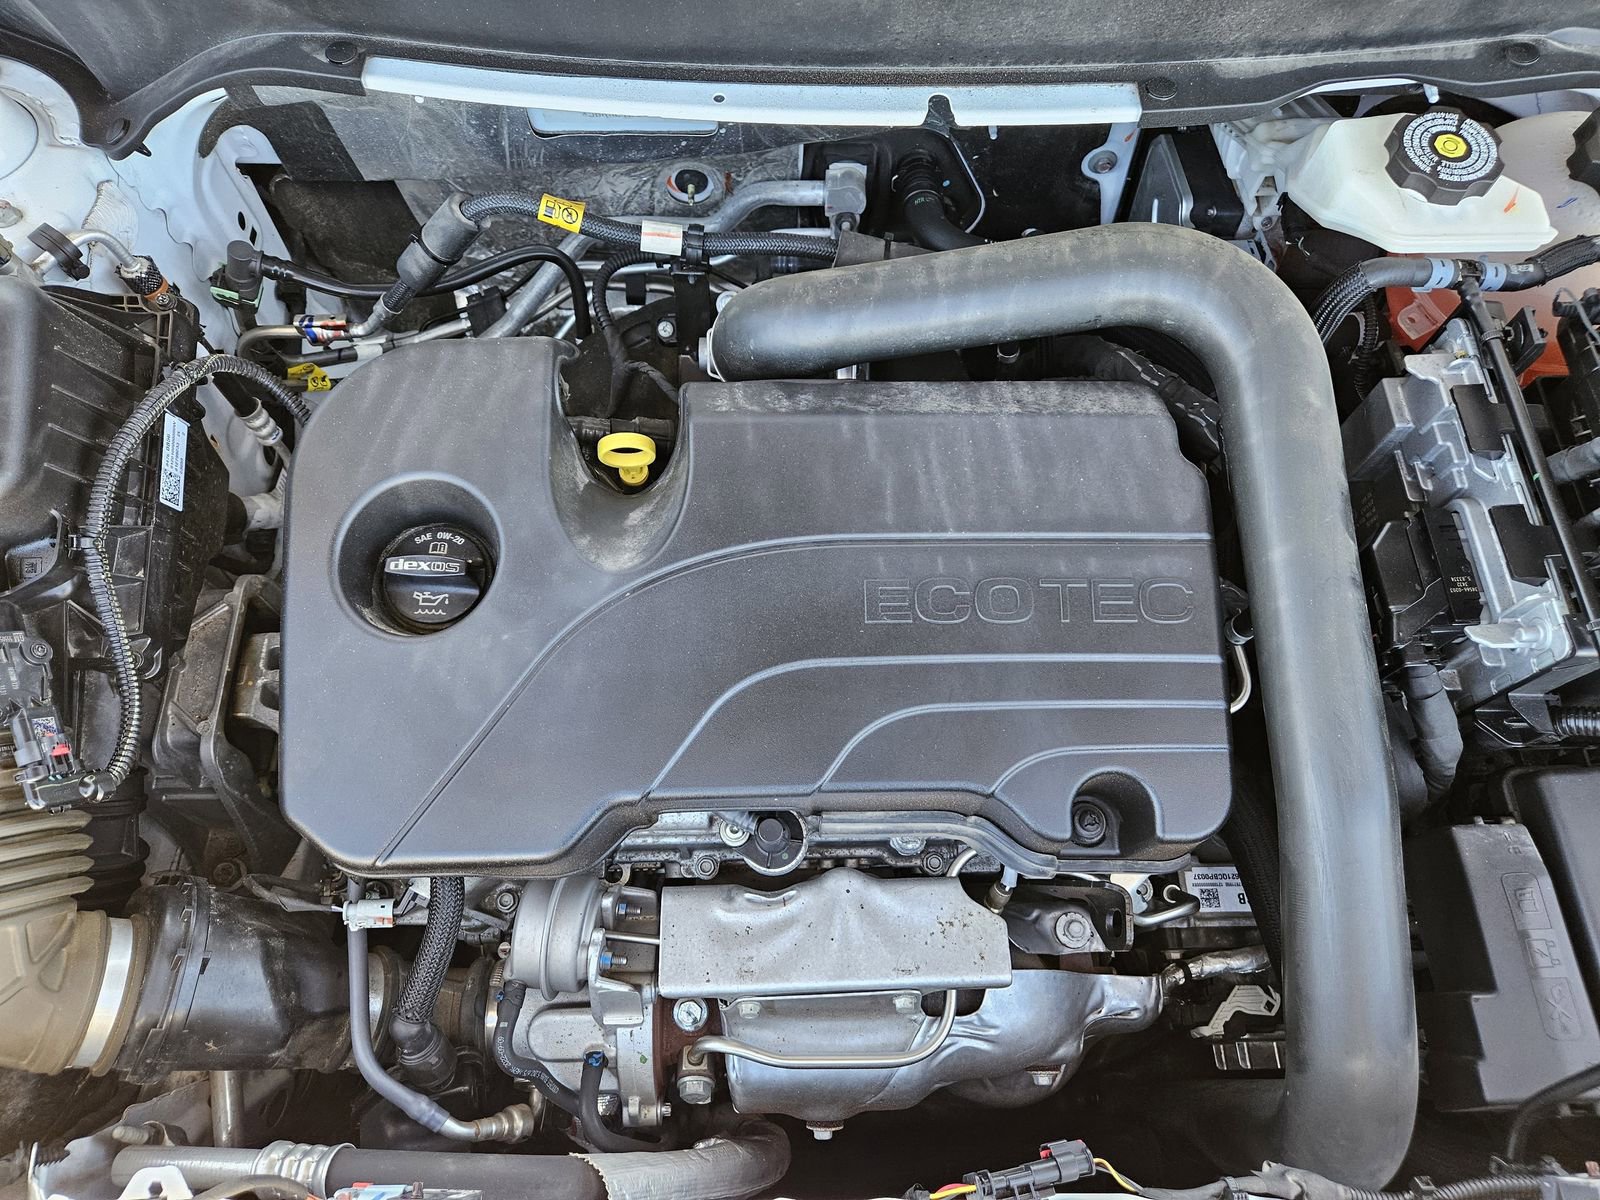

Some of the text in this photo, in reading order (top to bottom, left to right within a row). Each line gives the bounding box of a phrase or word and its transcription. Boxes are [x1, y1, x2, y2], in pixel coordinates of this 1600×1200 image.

[414, 532, 465, 545] SAE 0W-20
[389, 558, 460, 572] dexos
[864, 577, 1194, 624] ECOTEC
[1238, 892, 1246, 904] B
